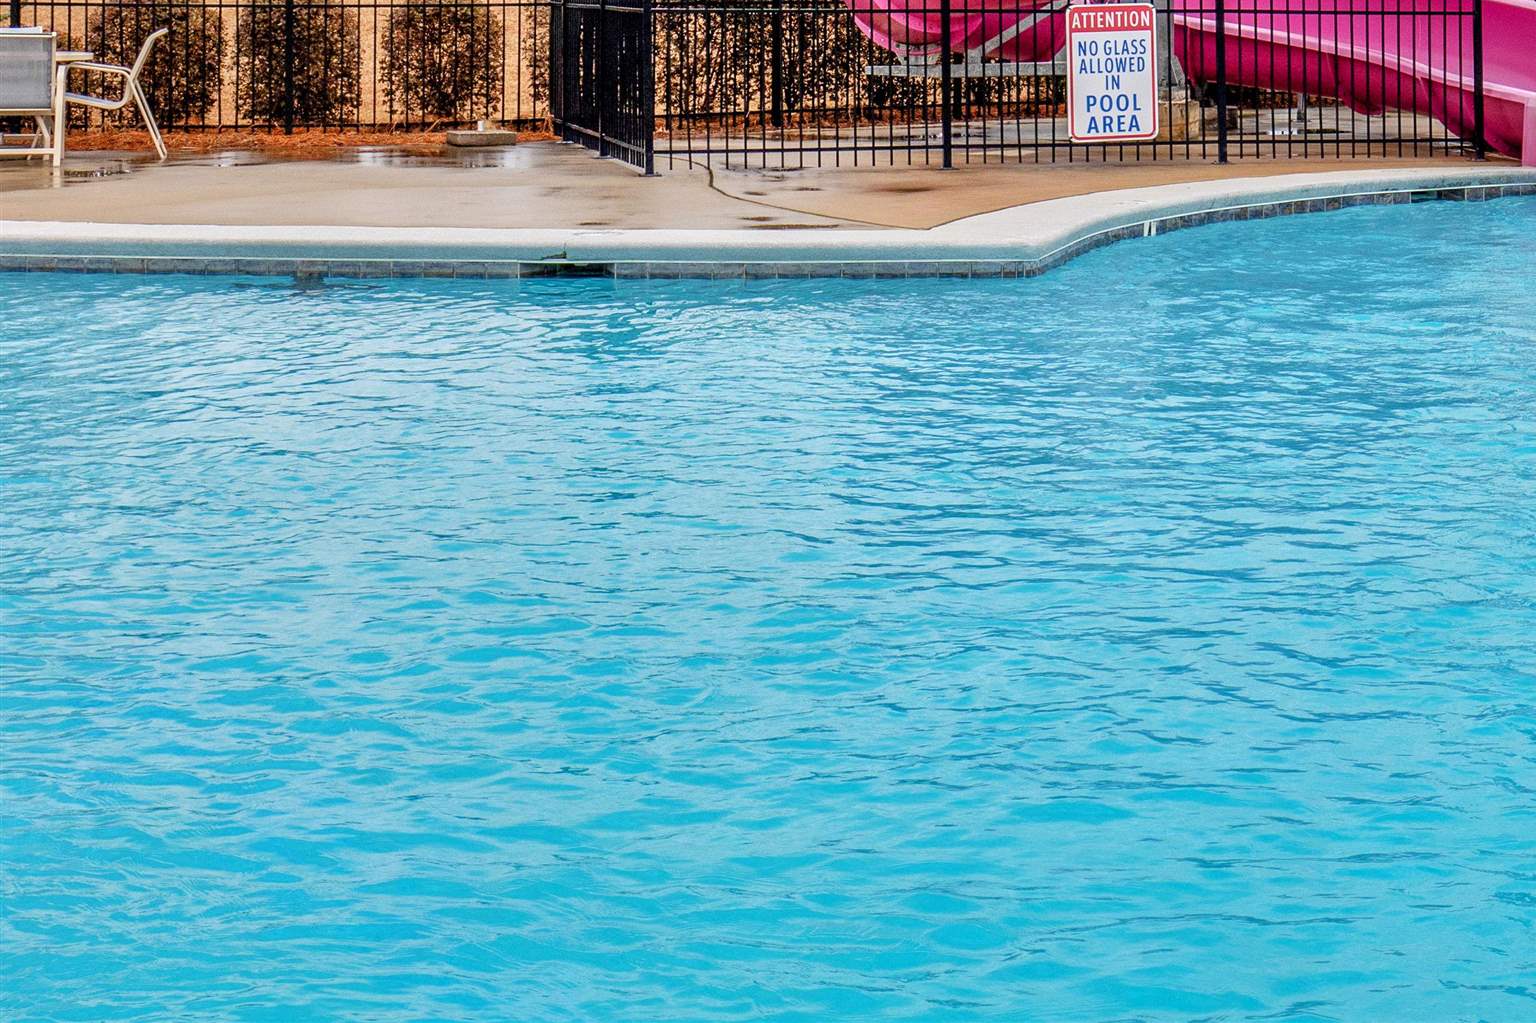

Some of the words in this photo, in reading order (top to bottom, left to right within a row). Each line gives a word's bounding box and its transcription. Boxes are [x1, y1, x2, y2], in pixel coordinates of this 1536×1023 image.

[1072, 10, 1150, 29] ATTENTION
[1078, 40, 1098, 57] NO
[1104, 39, 1146, 55] GLASS
[1079, 56, 1145, 74] ALLOWED
[1105, 75, 1120, 90] IN
[1086, 94, 1141, 113] POOL
[1087, 114, 1141, 134] AREA
